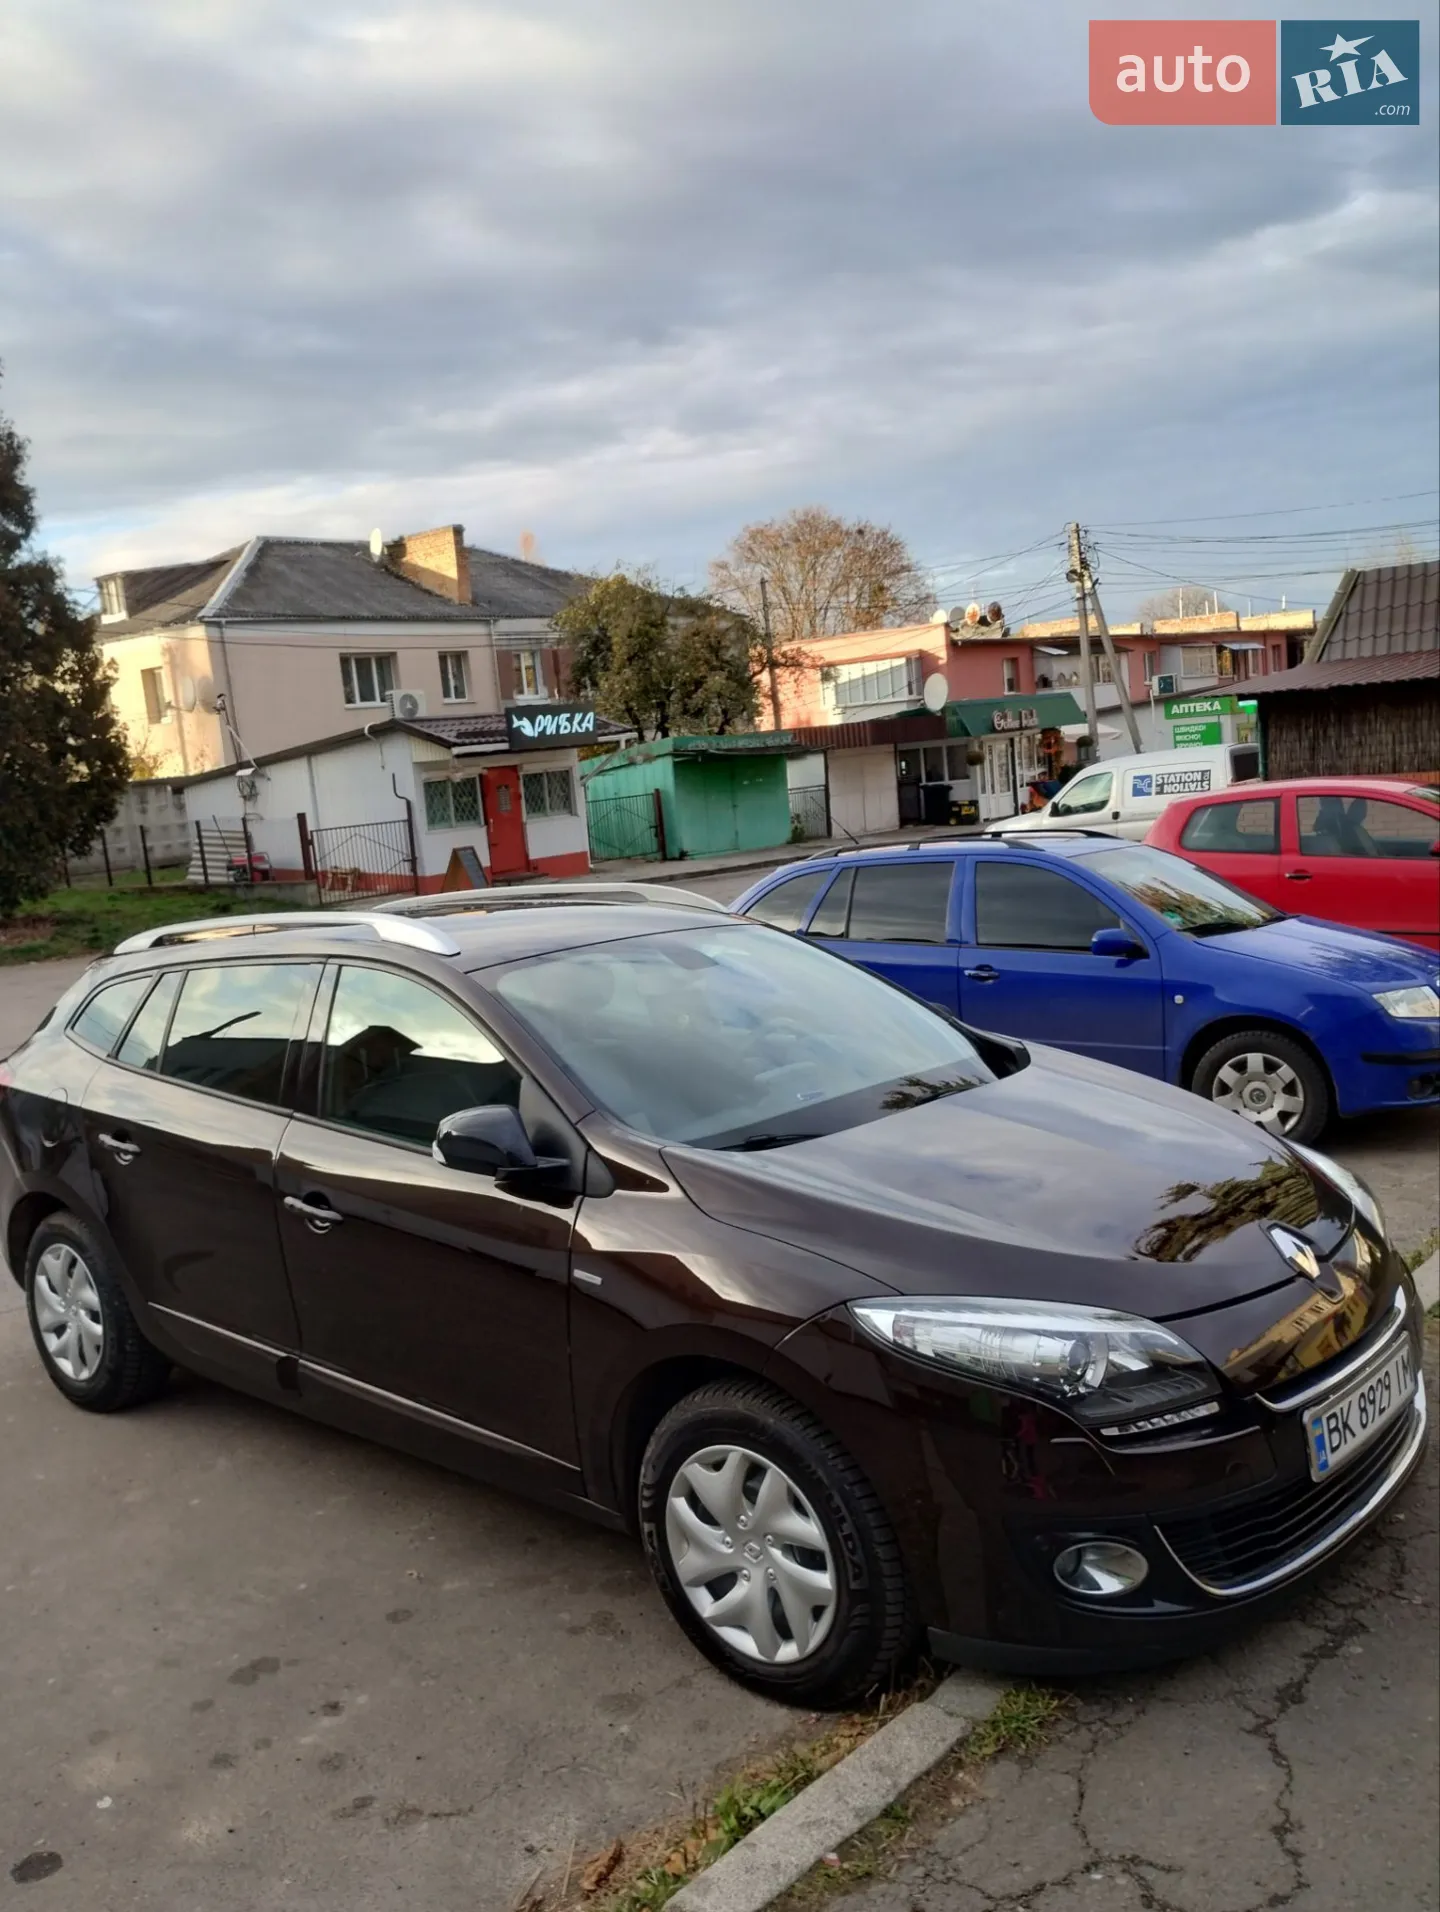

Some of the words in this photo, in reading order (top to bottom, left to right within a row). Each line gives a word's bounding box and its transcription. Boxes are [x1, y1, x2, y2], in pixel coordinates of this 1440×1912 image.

[1171, 700, 1222, 715] АПТЕКА
[534, 711, 595, 738] РИБКА
[1156, 771, 1202, 784] STATION
[1326, 1400, 1356, 1454] BK
[1358, 1369, 1392, 1430] 8929
